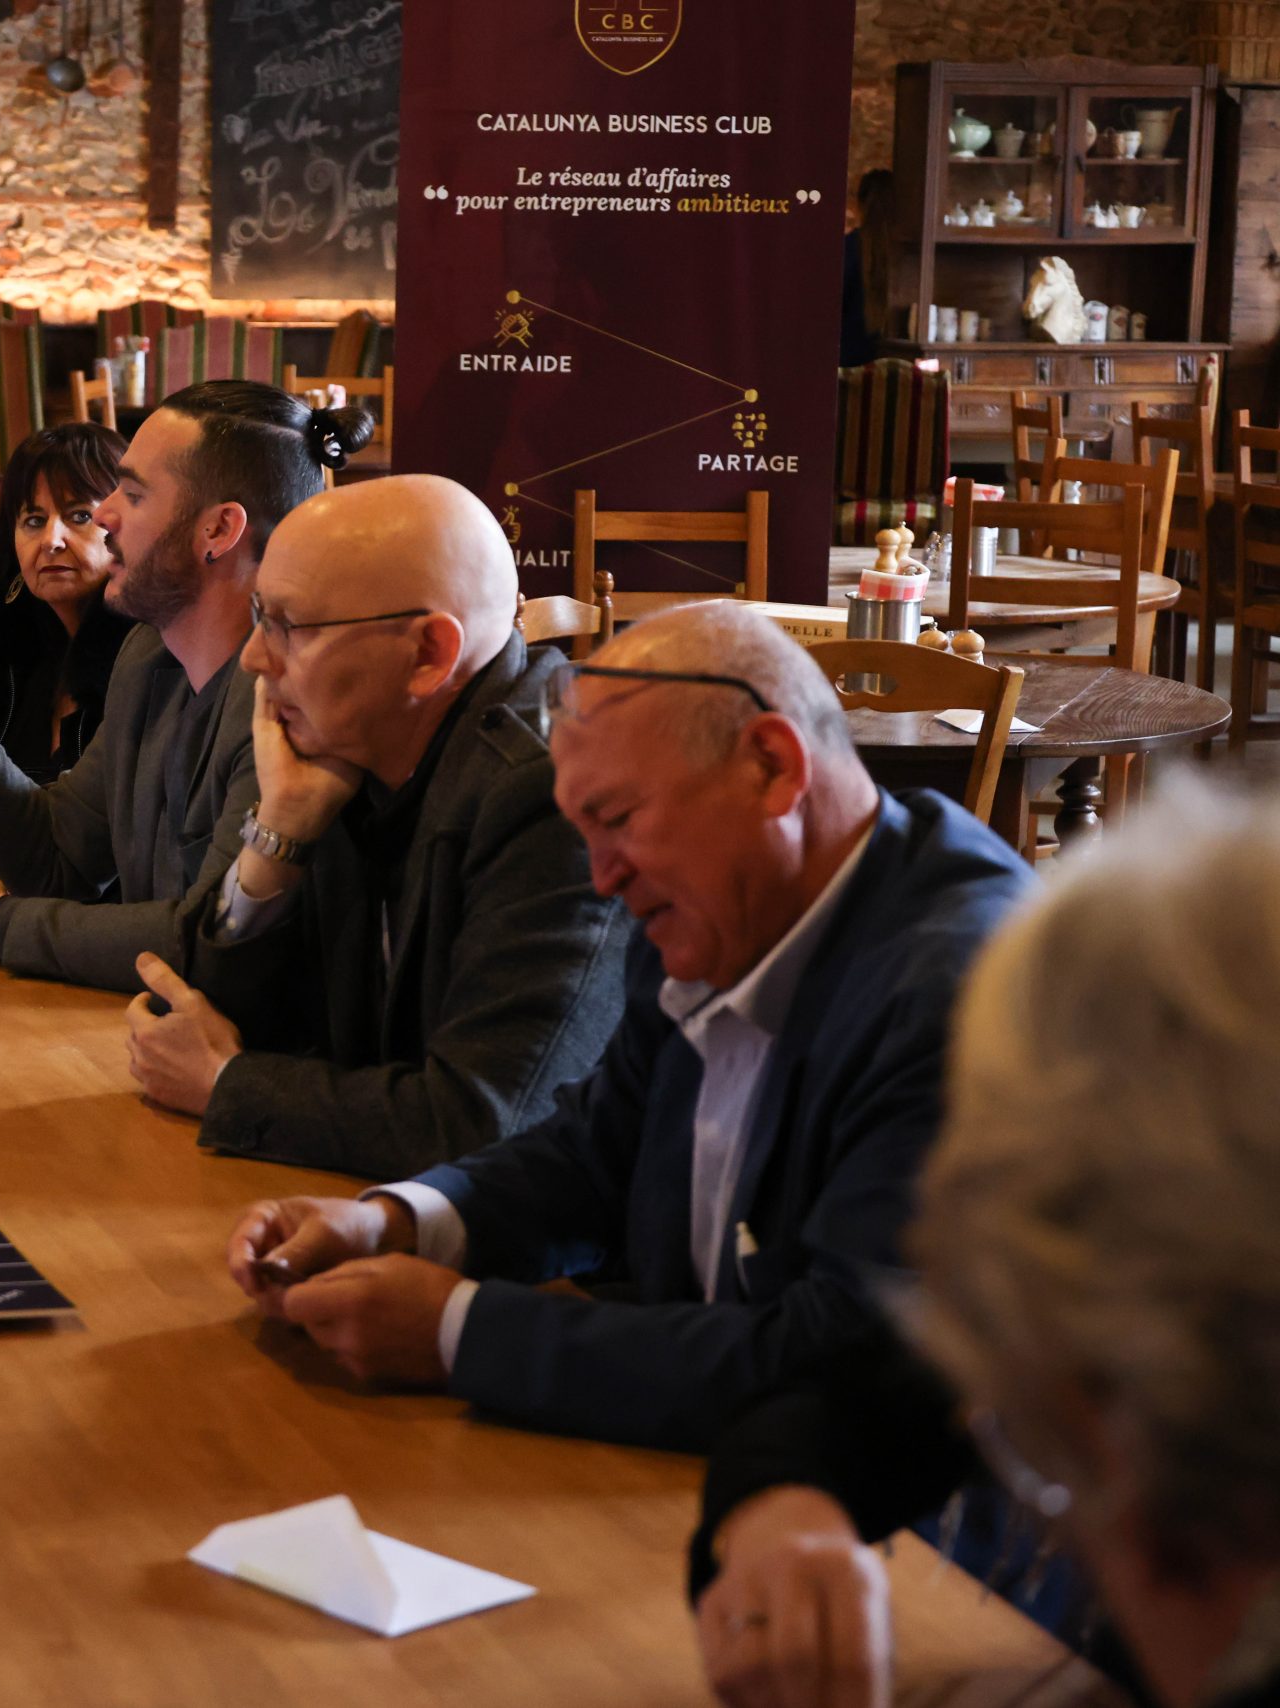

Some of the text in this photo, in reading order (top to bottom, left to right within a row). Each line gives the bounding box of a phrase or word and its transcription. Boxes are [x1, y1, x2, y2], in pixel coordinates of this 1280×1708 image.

[601, 13, 654, 30] CBC
[477, 113, 772, 135] CATALUNYA BUSINESS CLUB
[517, 167, 543, 186] Le
[549, 166, 621, 187] réseau
[456, 193, 789, 216] pour entrepreneurs ambitieux
[459, 353, 572, 373] ENTRAIDE
[698, 453, 799, 473] PARTAGE
[516, 549, 571, 567] IALIT
